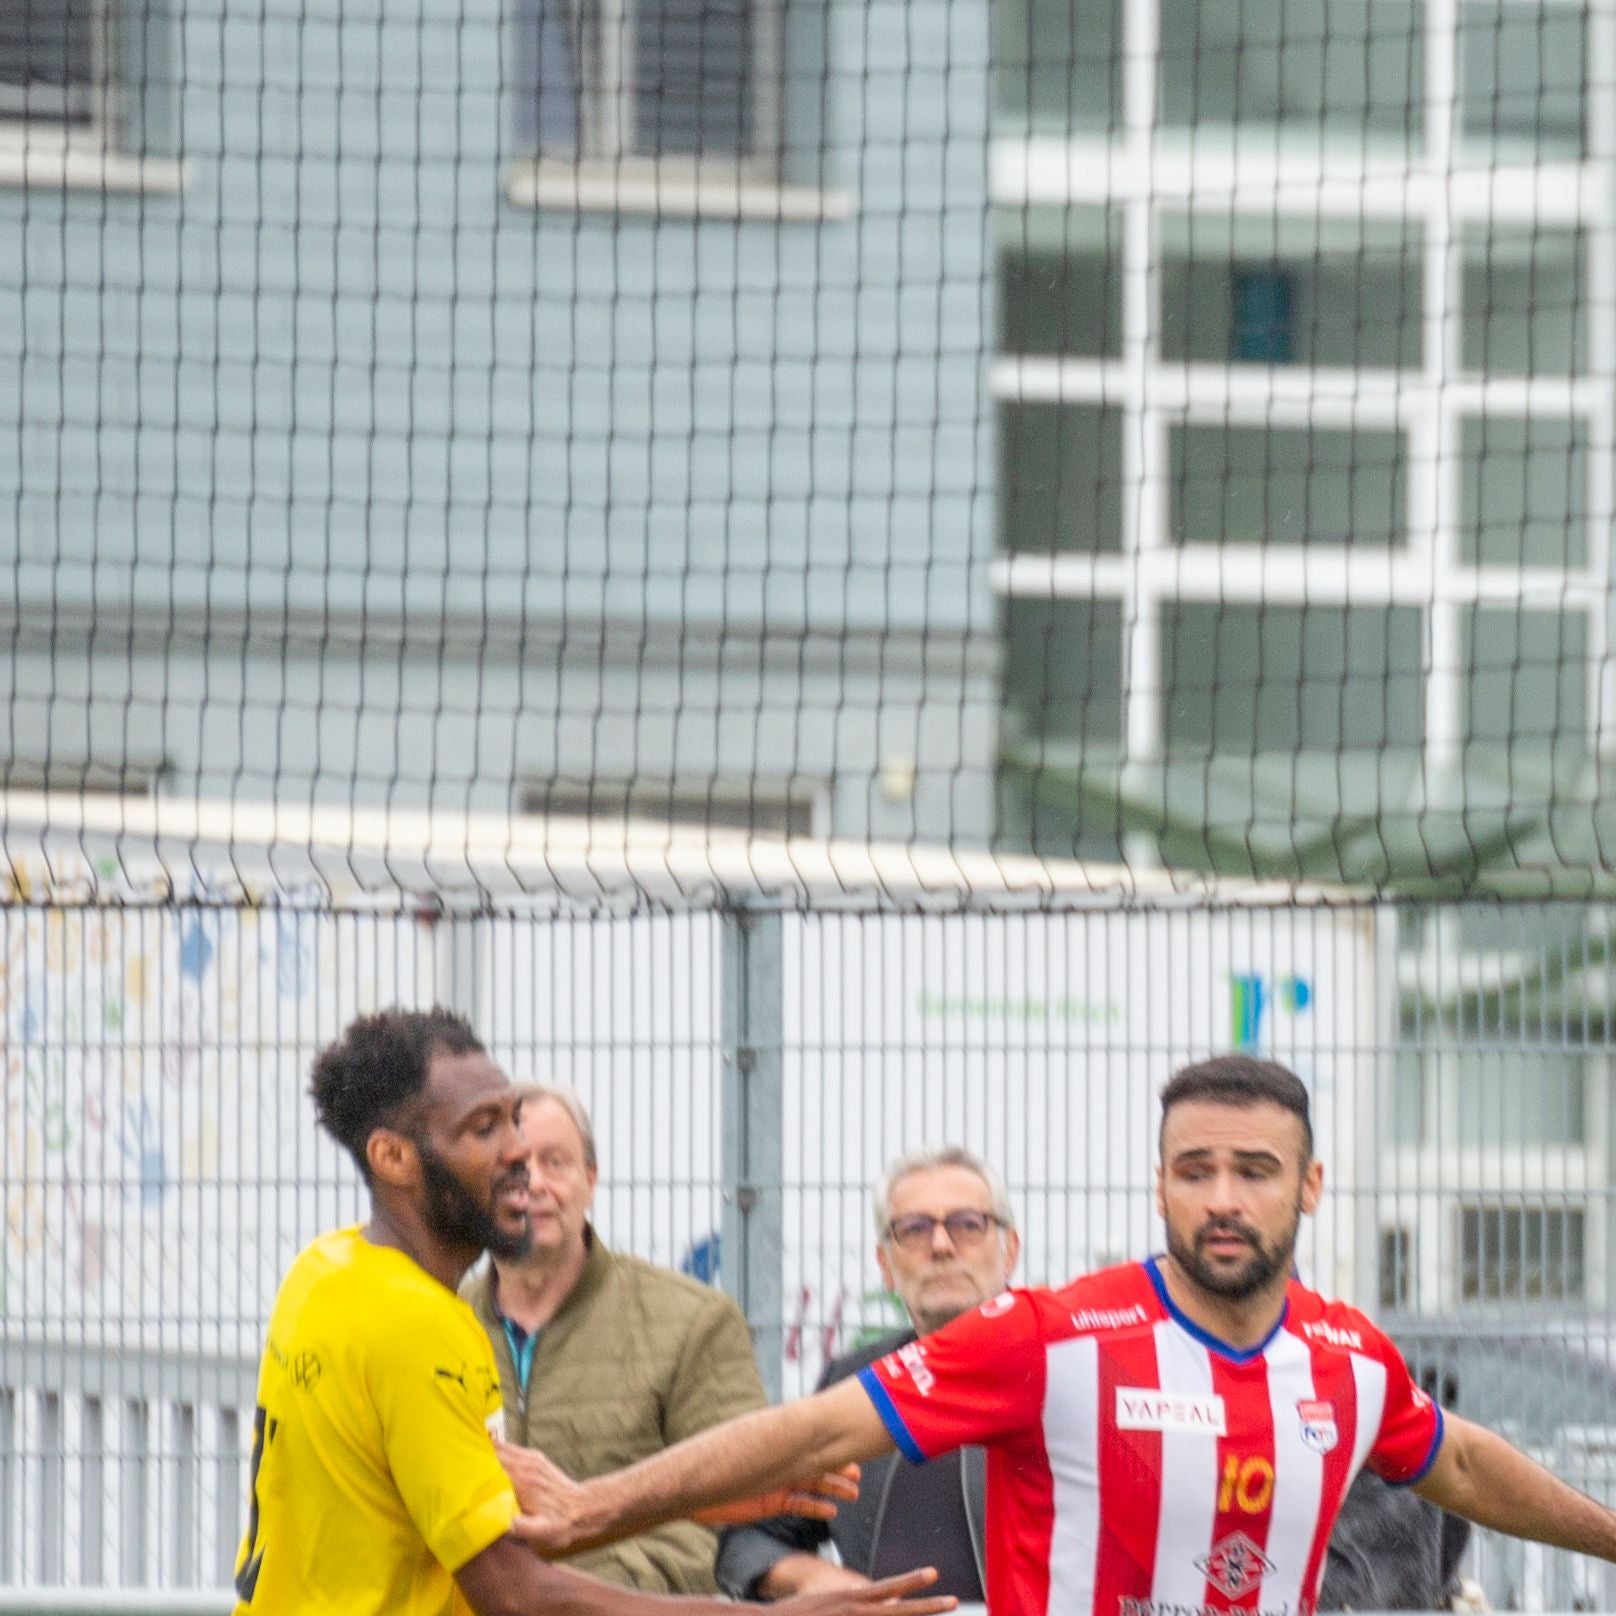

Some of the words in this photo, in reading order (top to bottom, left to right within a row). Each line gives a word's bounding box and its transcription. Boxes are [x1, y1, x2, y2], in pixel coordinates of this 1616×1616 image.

[1069, 1303, 1148, 1331] uhlsport
[1121, 1397, 1222, 1427] YAPEAL
[1217, 1454, 1276, 1516] 10
